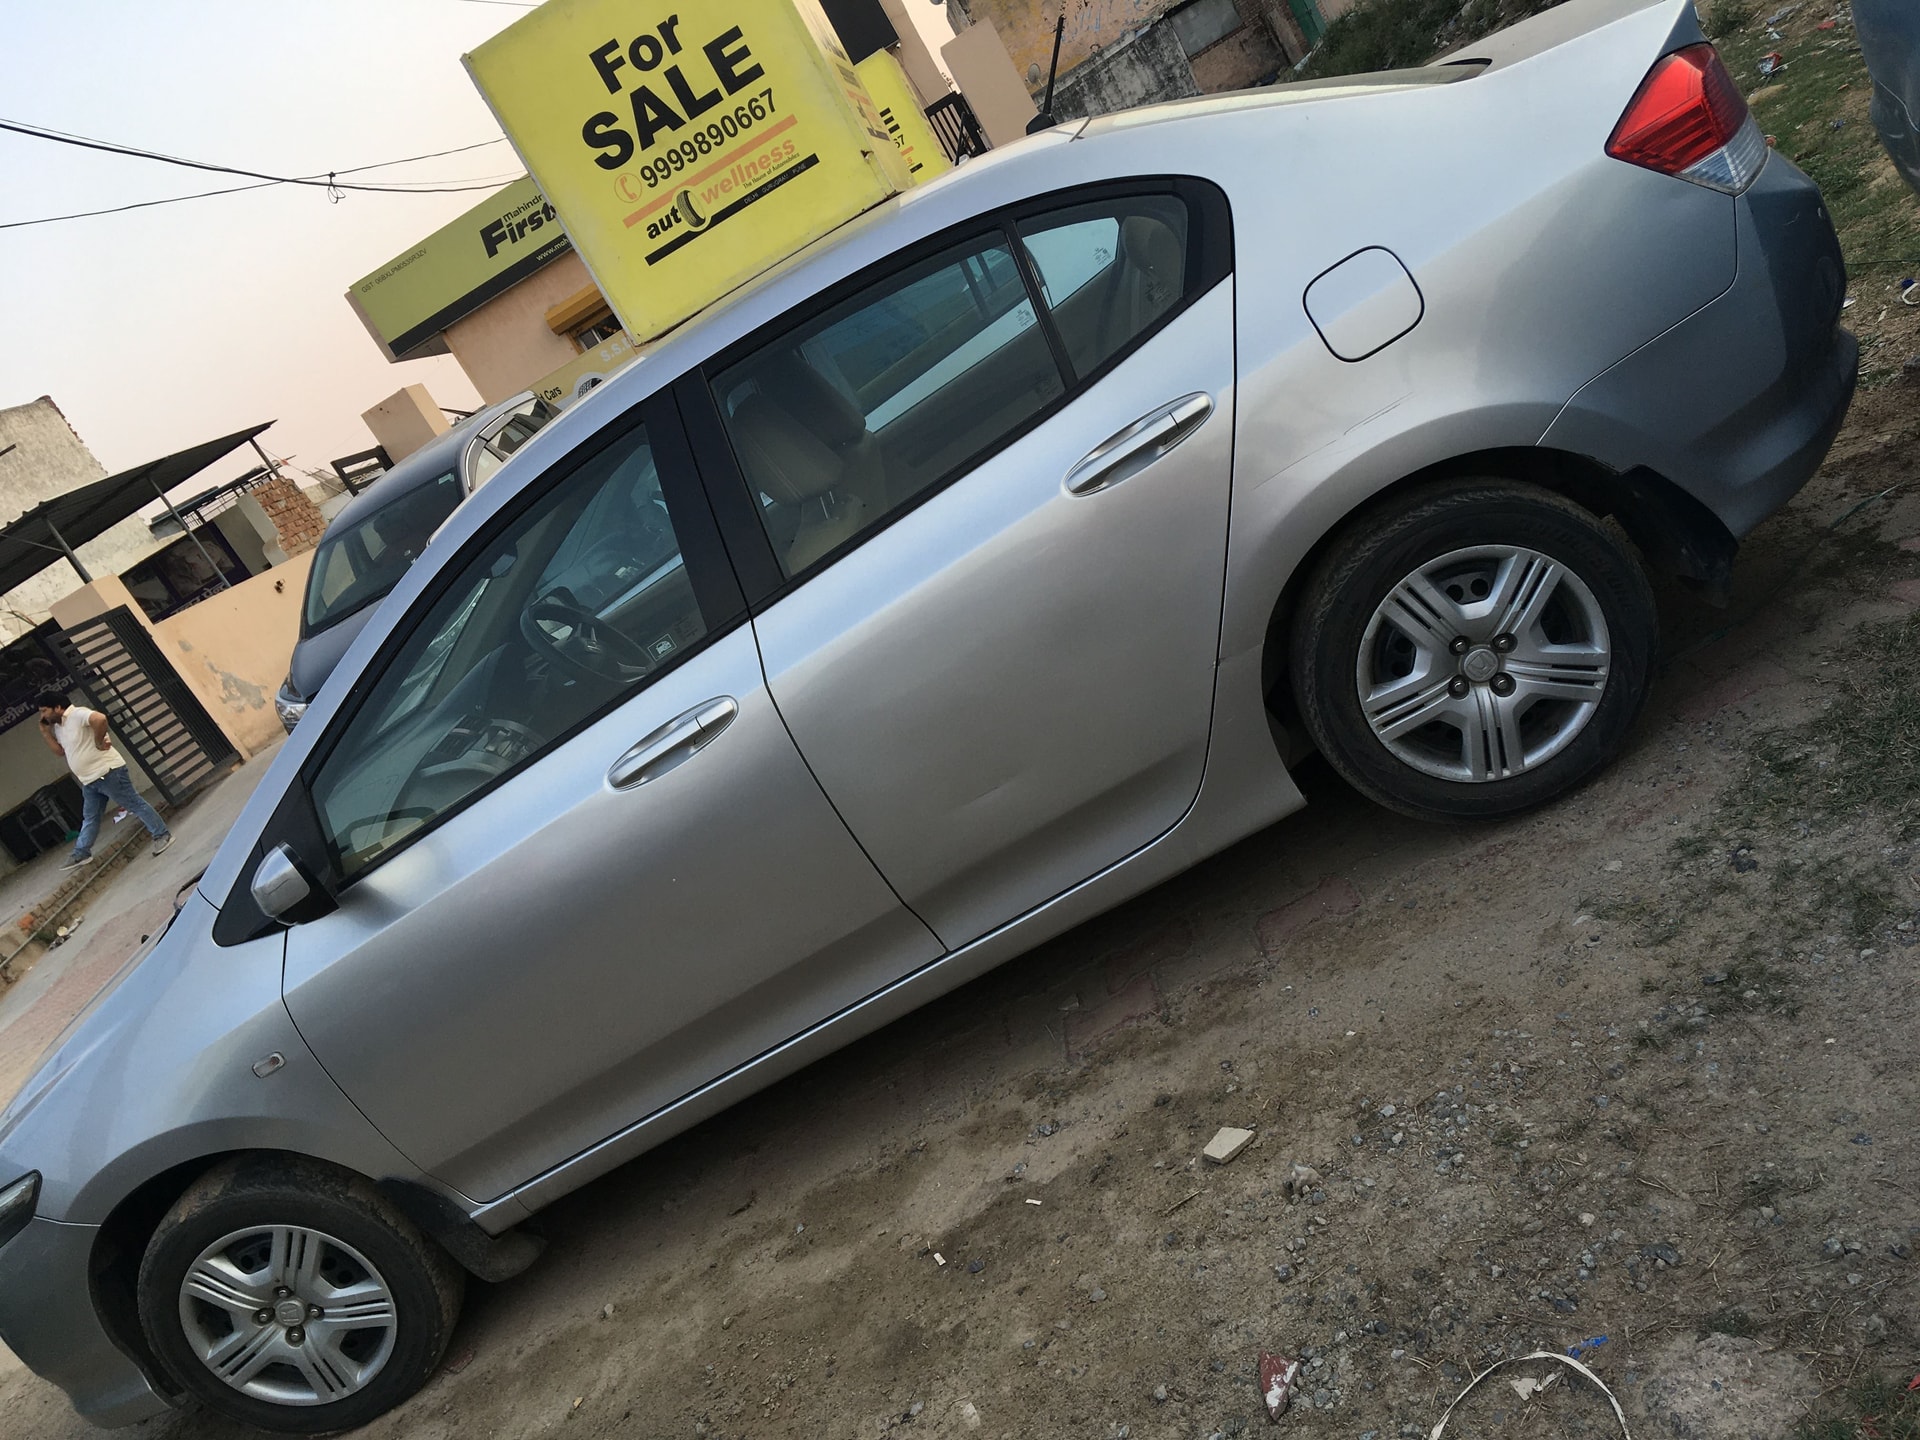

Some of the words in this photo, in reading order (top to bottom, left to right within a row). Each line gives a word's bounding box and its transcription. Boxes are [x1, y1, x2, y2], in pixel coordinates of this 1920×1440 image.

[588, 13, 680, 94] For
[582, 25, 765, 170] SALE
[639, 87, 777, 188] 9999890667
[701, 139, 796, 205] wellness
[480, 202, 556, 259] First
[503, 193, 544, 222] Mahindr
[536, 237, 569, 261] www.mah
[544, 386, 562, 401] Cars
